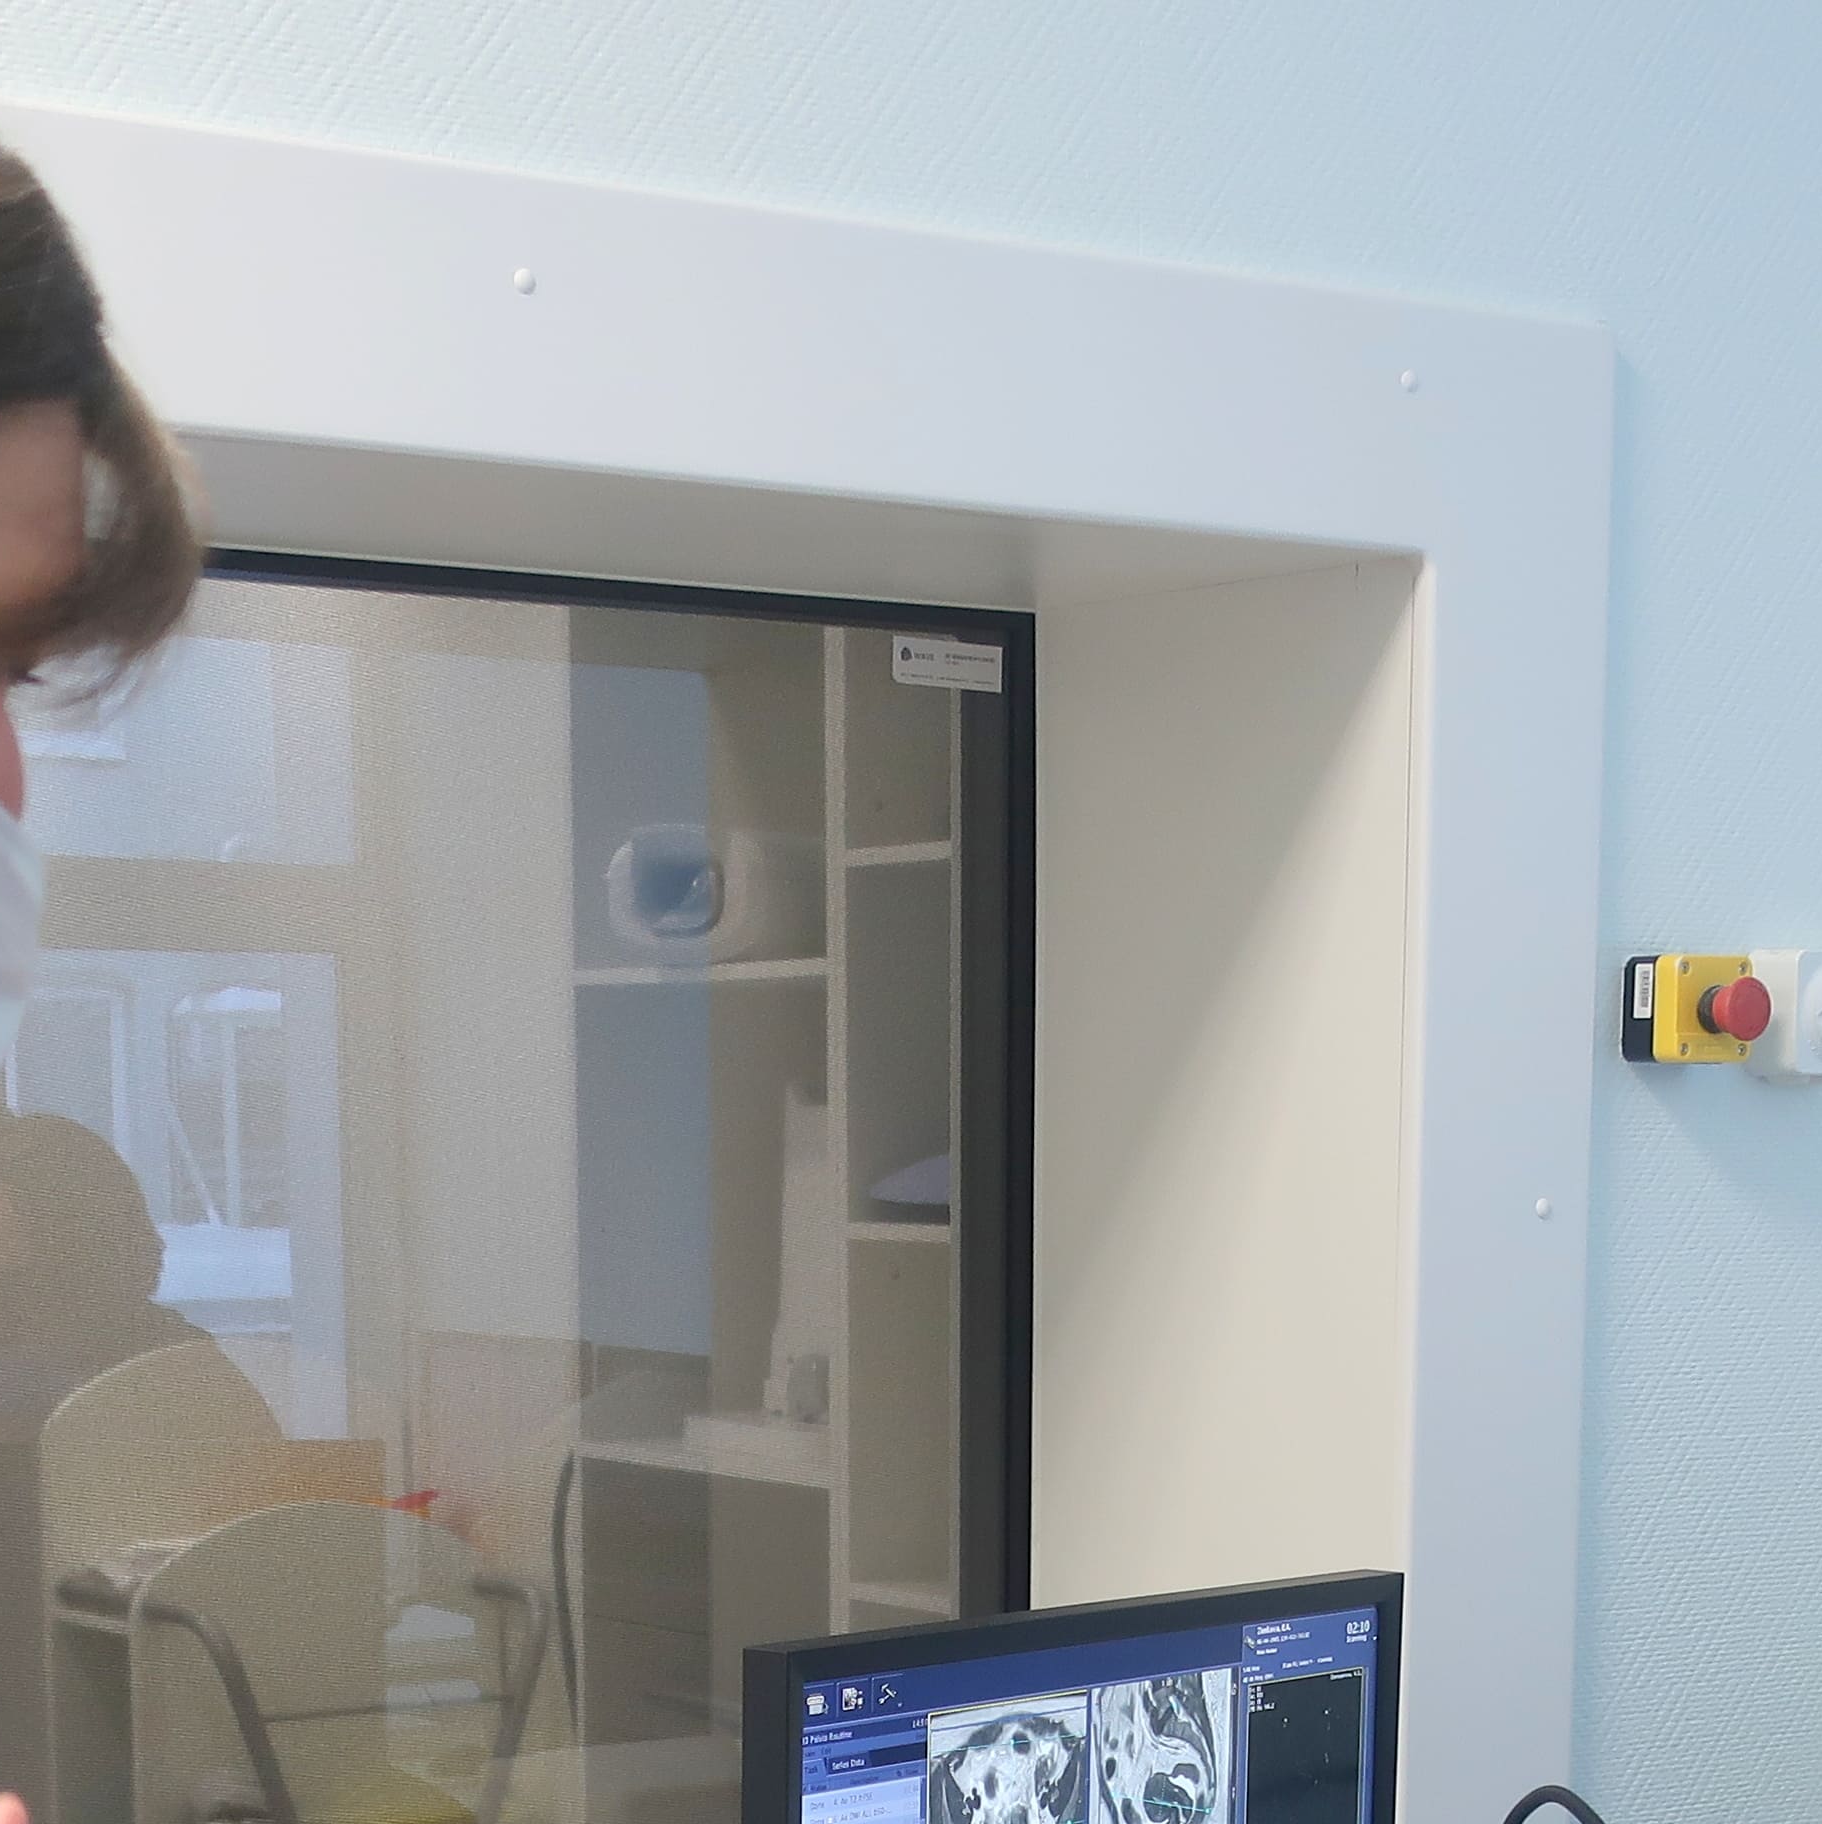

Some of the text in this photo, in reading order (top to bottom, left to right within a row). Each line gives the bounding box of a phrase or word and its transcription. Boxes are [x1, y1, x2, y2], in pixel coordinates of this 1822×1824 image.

[1346, 1620, 1370, 1635] 02:10
[832, 1758, 866, 1771] Series Data
